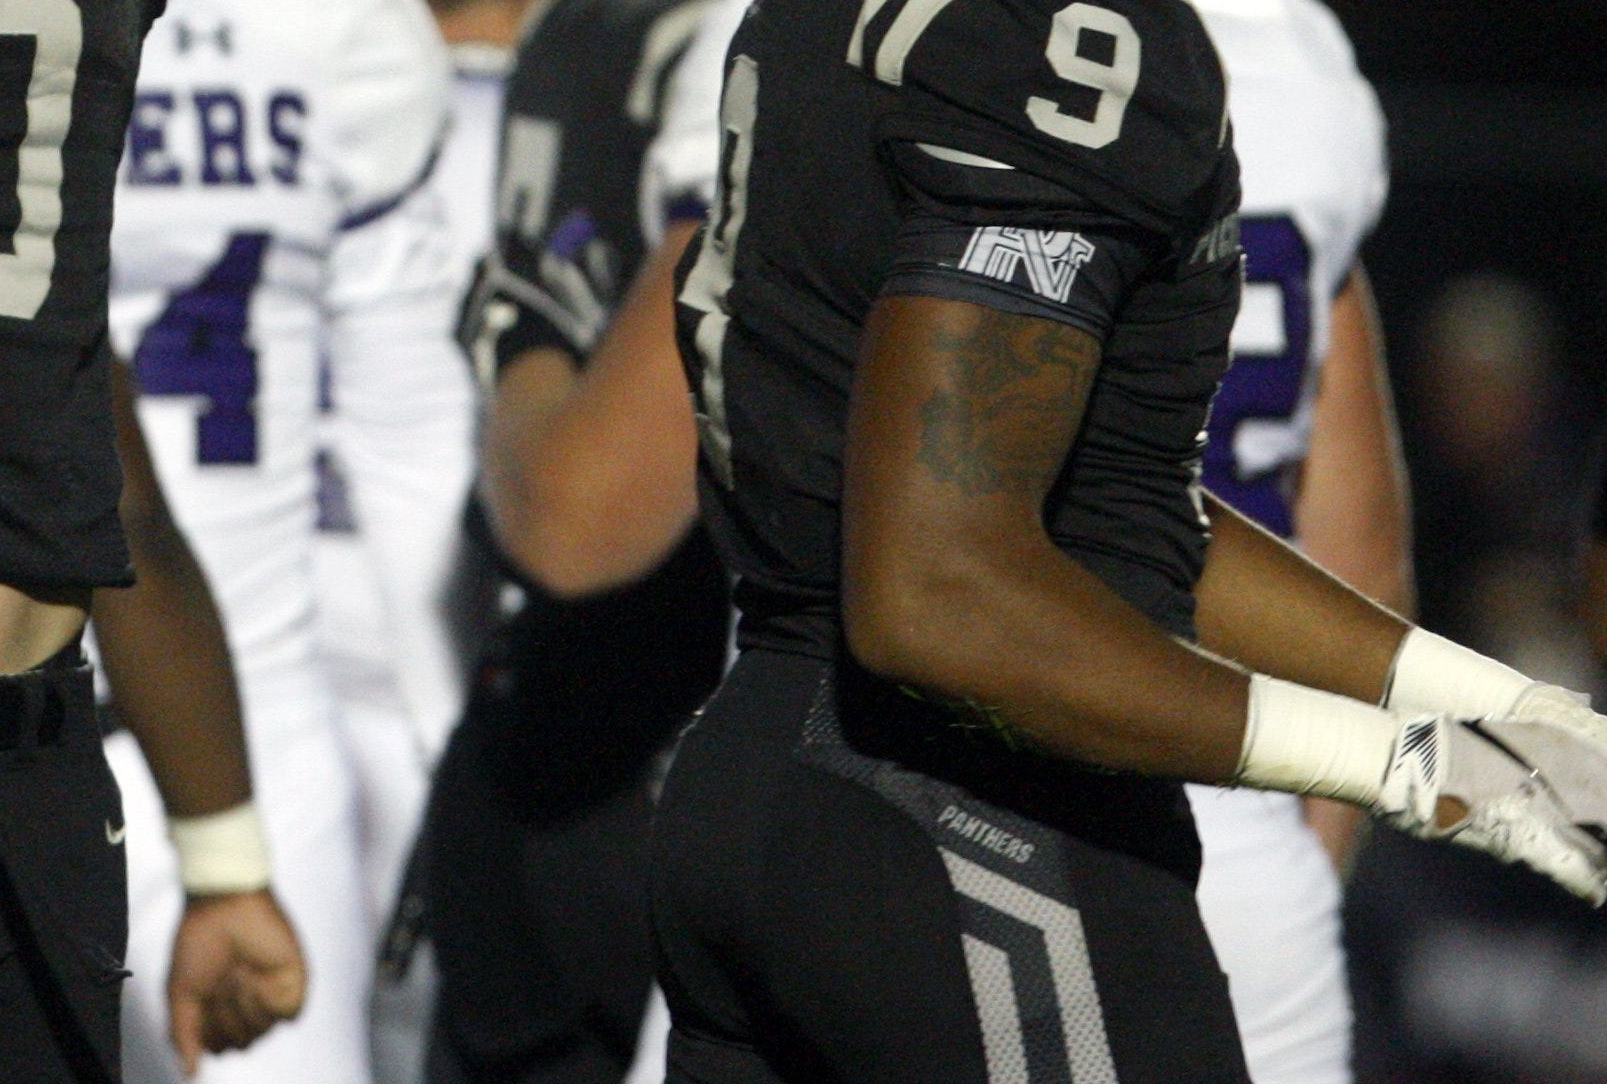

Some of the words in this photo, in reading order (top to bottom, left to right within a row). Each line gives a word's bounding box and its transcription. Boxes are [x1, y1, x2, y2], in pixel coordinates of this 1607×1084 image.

[1025, 3, 1141, 150] 9
[133, 231, 271, 465] 4
[937, 804, 1035, 864] PANTHERS
